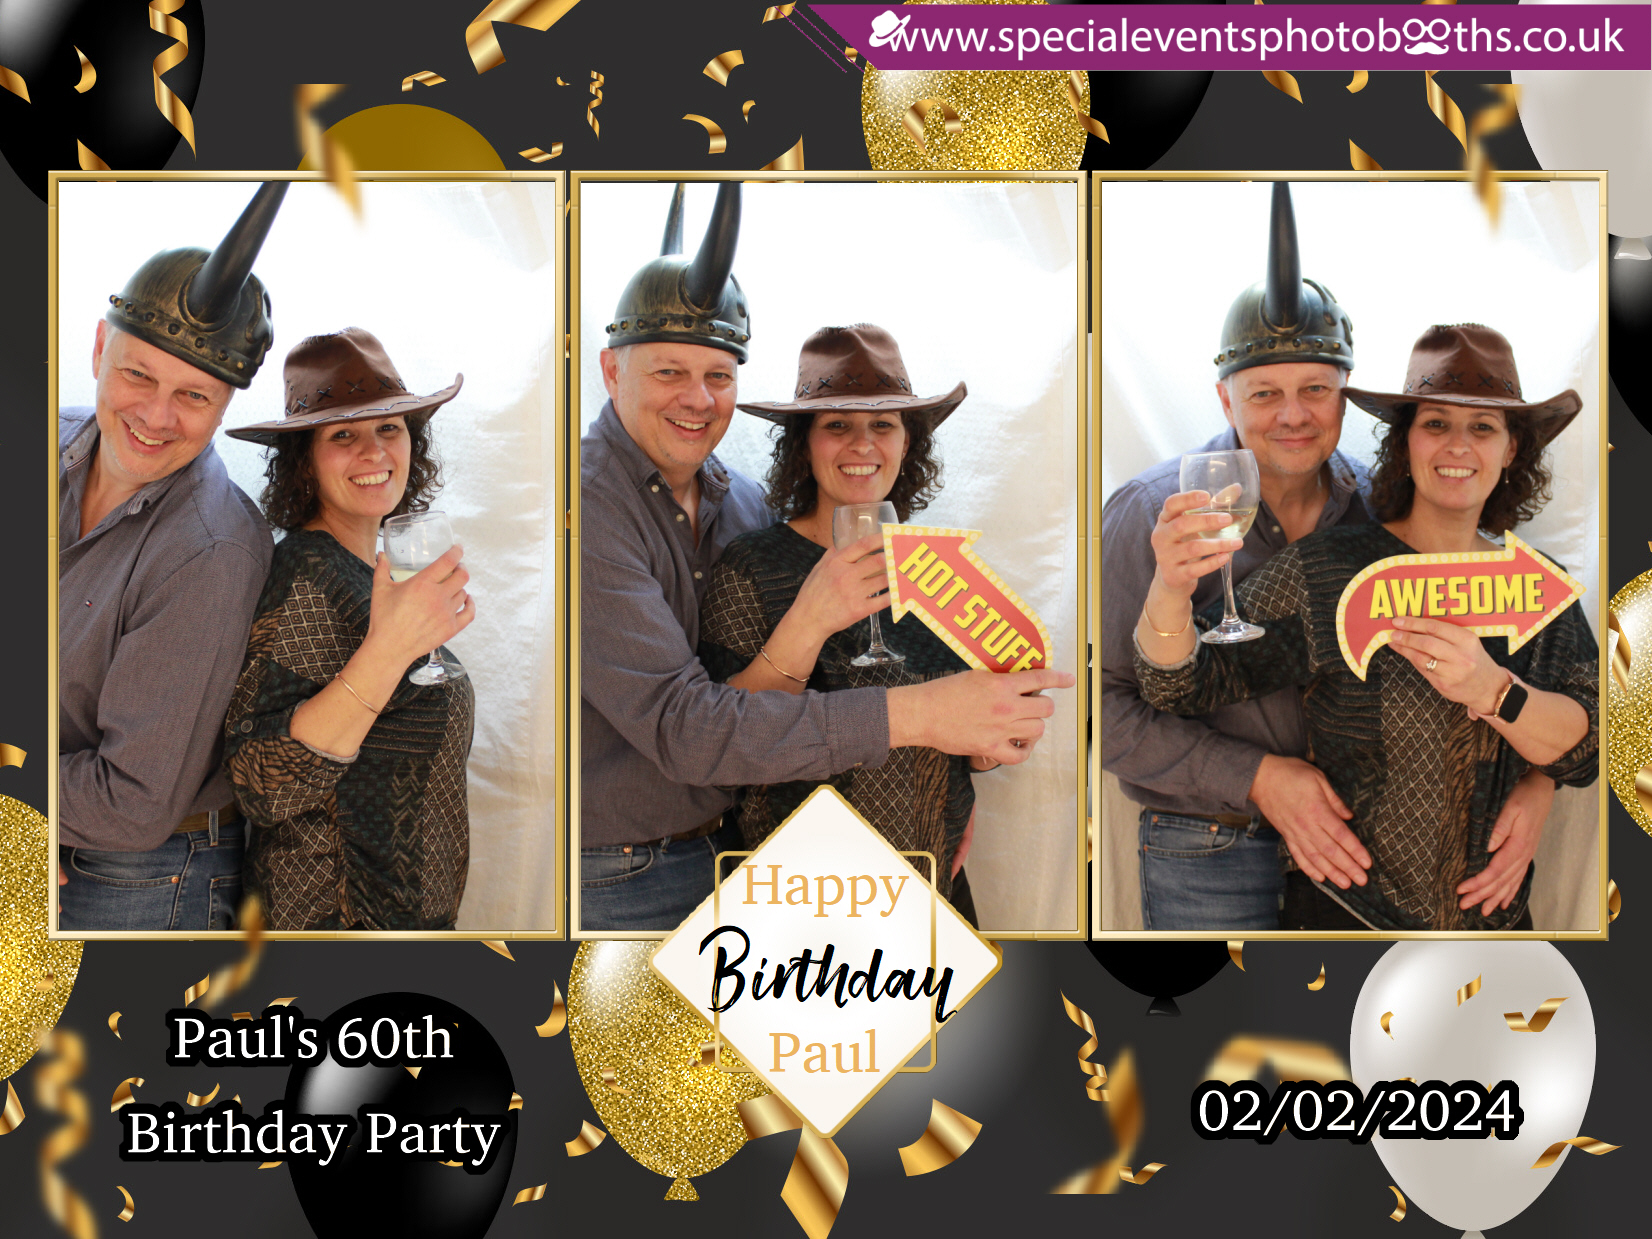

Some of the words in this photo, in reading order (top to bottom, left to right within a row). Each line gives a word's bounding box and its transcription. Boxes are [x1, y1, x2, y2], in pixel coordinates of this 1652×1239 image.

[897, 541, 970, 610] HOT
[953, 593, 1044, 674] STUFF
[1369, 573, 1545, 619] AWESOME
